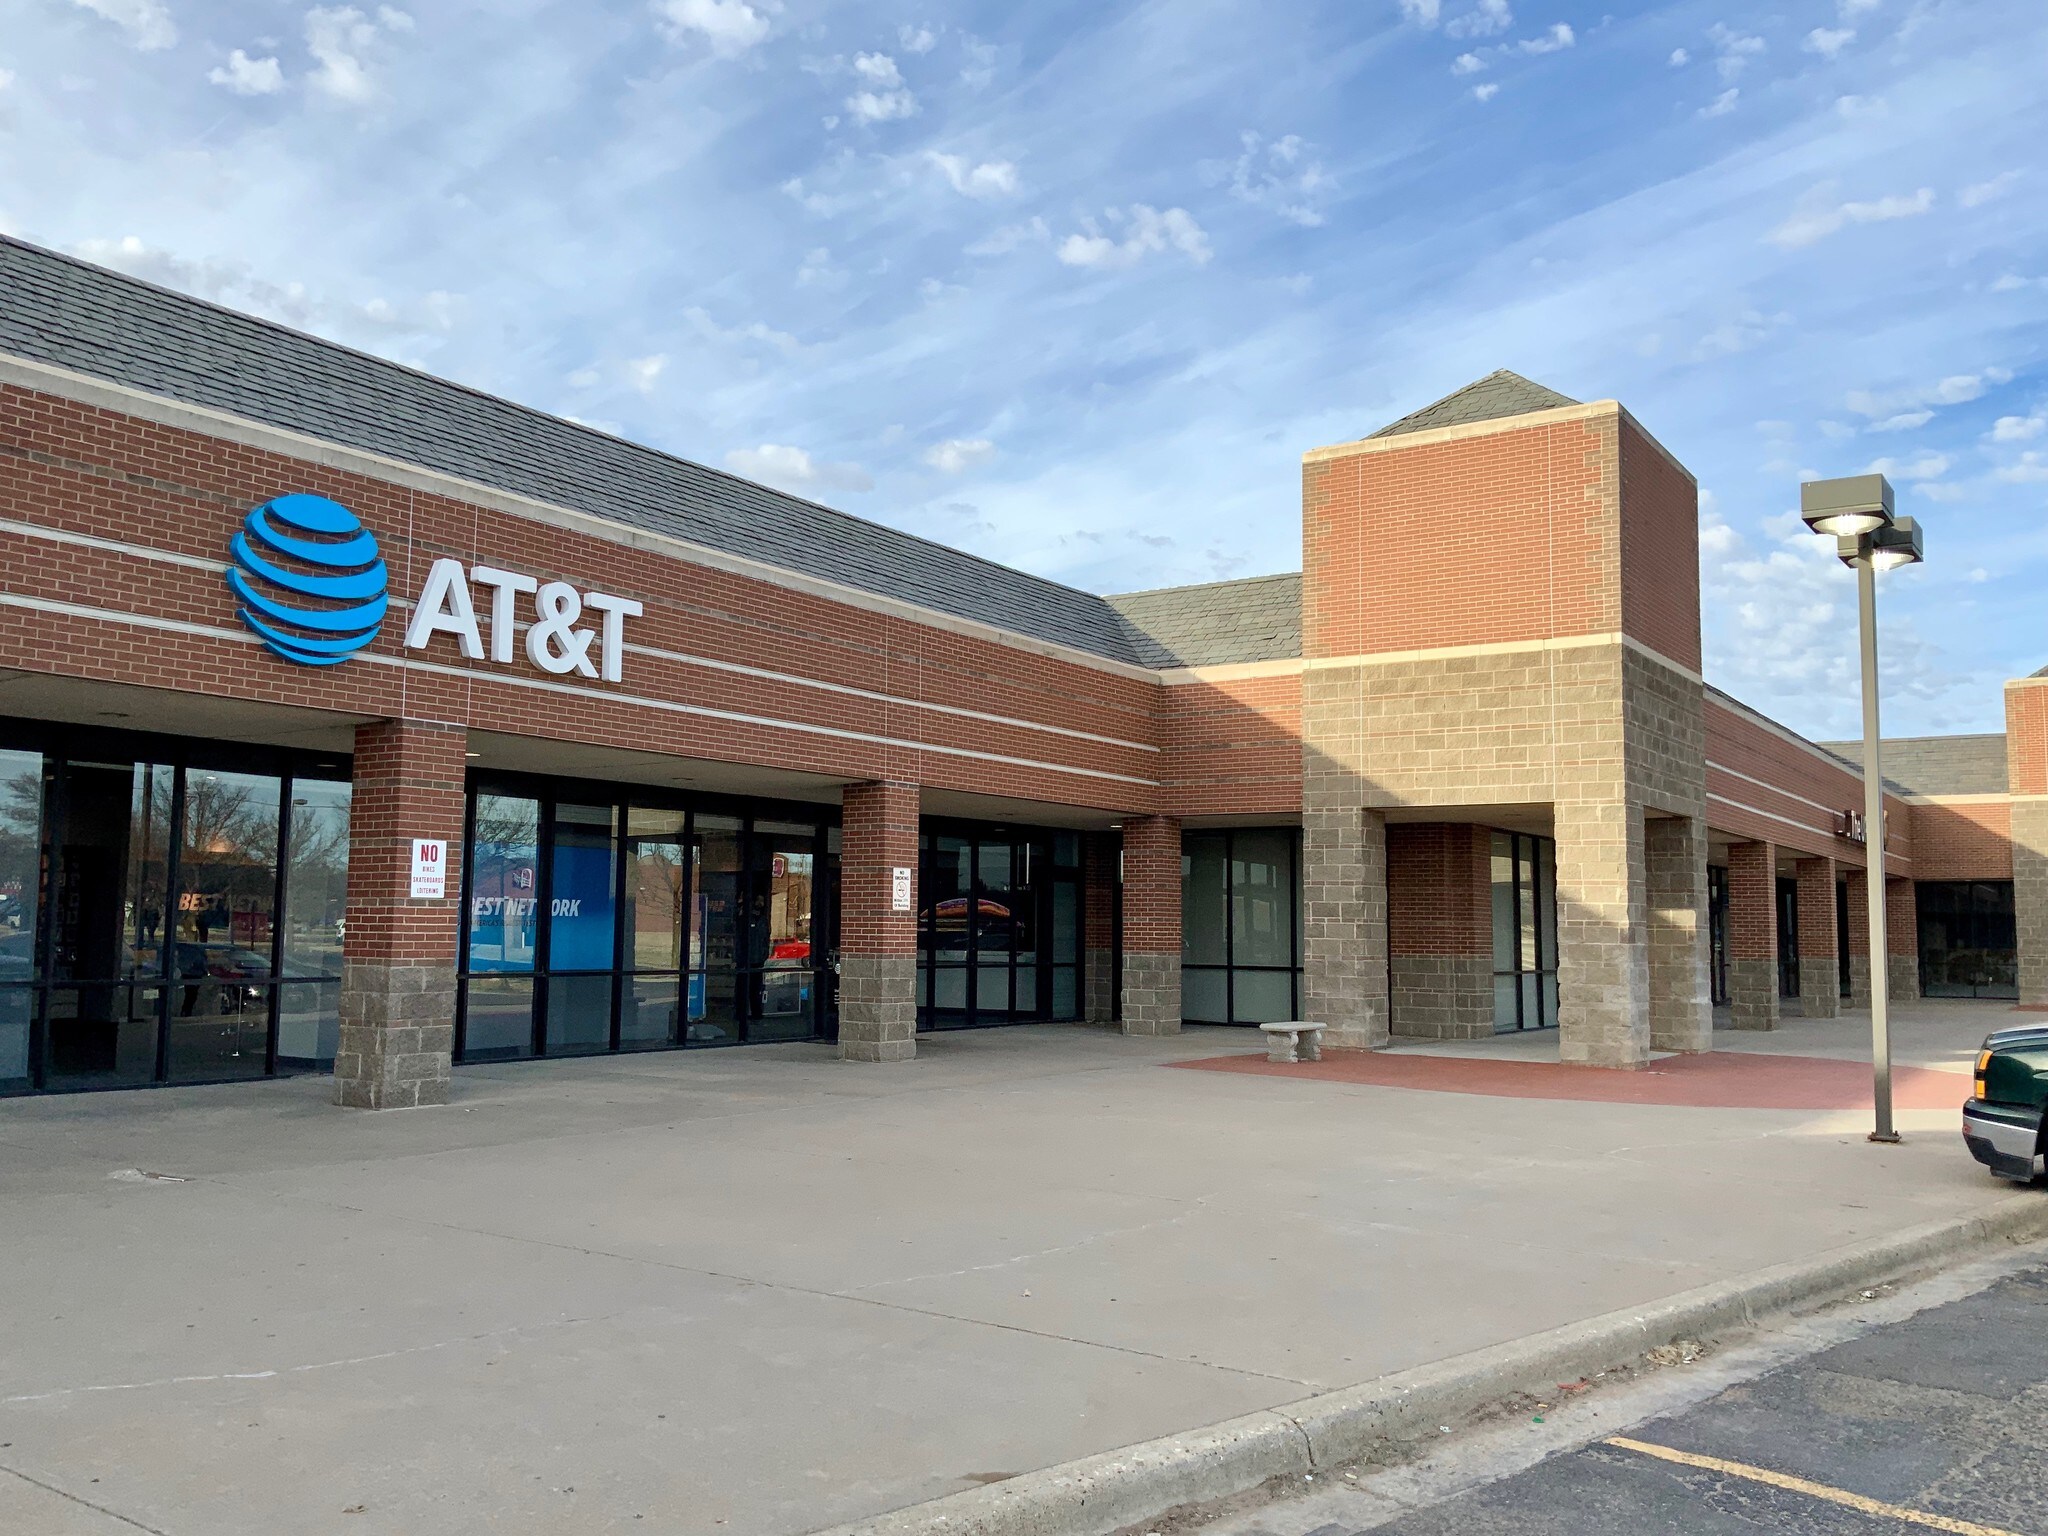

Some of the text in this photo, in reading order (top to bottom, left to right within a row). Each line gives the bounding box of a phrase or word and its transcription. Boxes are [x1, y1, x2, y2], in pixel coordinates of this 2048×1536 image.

[404, 558, 643, 683] AT&T
[420, 844, 439, 862] NO
[422, 865, 435, 873] BIKES
[412, 876, 444, 884] SKATEBOARDS
[178, 893, 222, 911] BEST
[505, 897, 581, 917] NETORK
